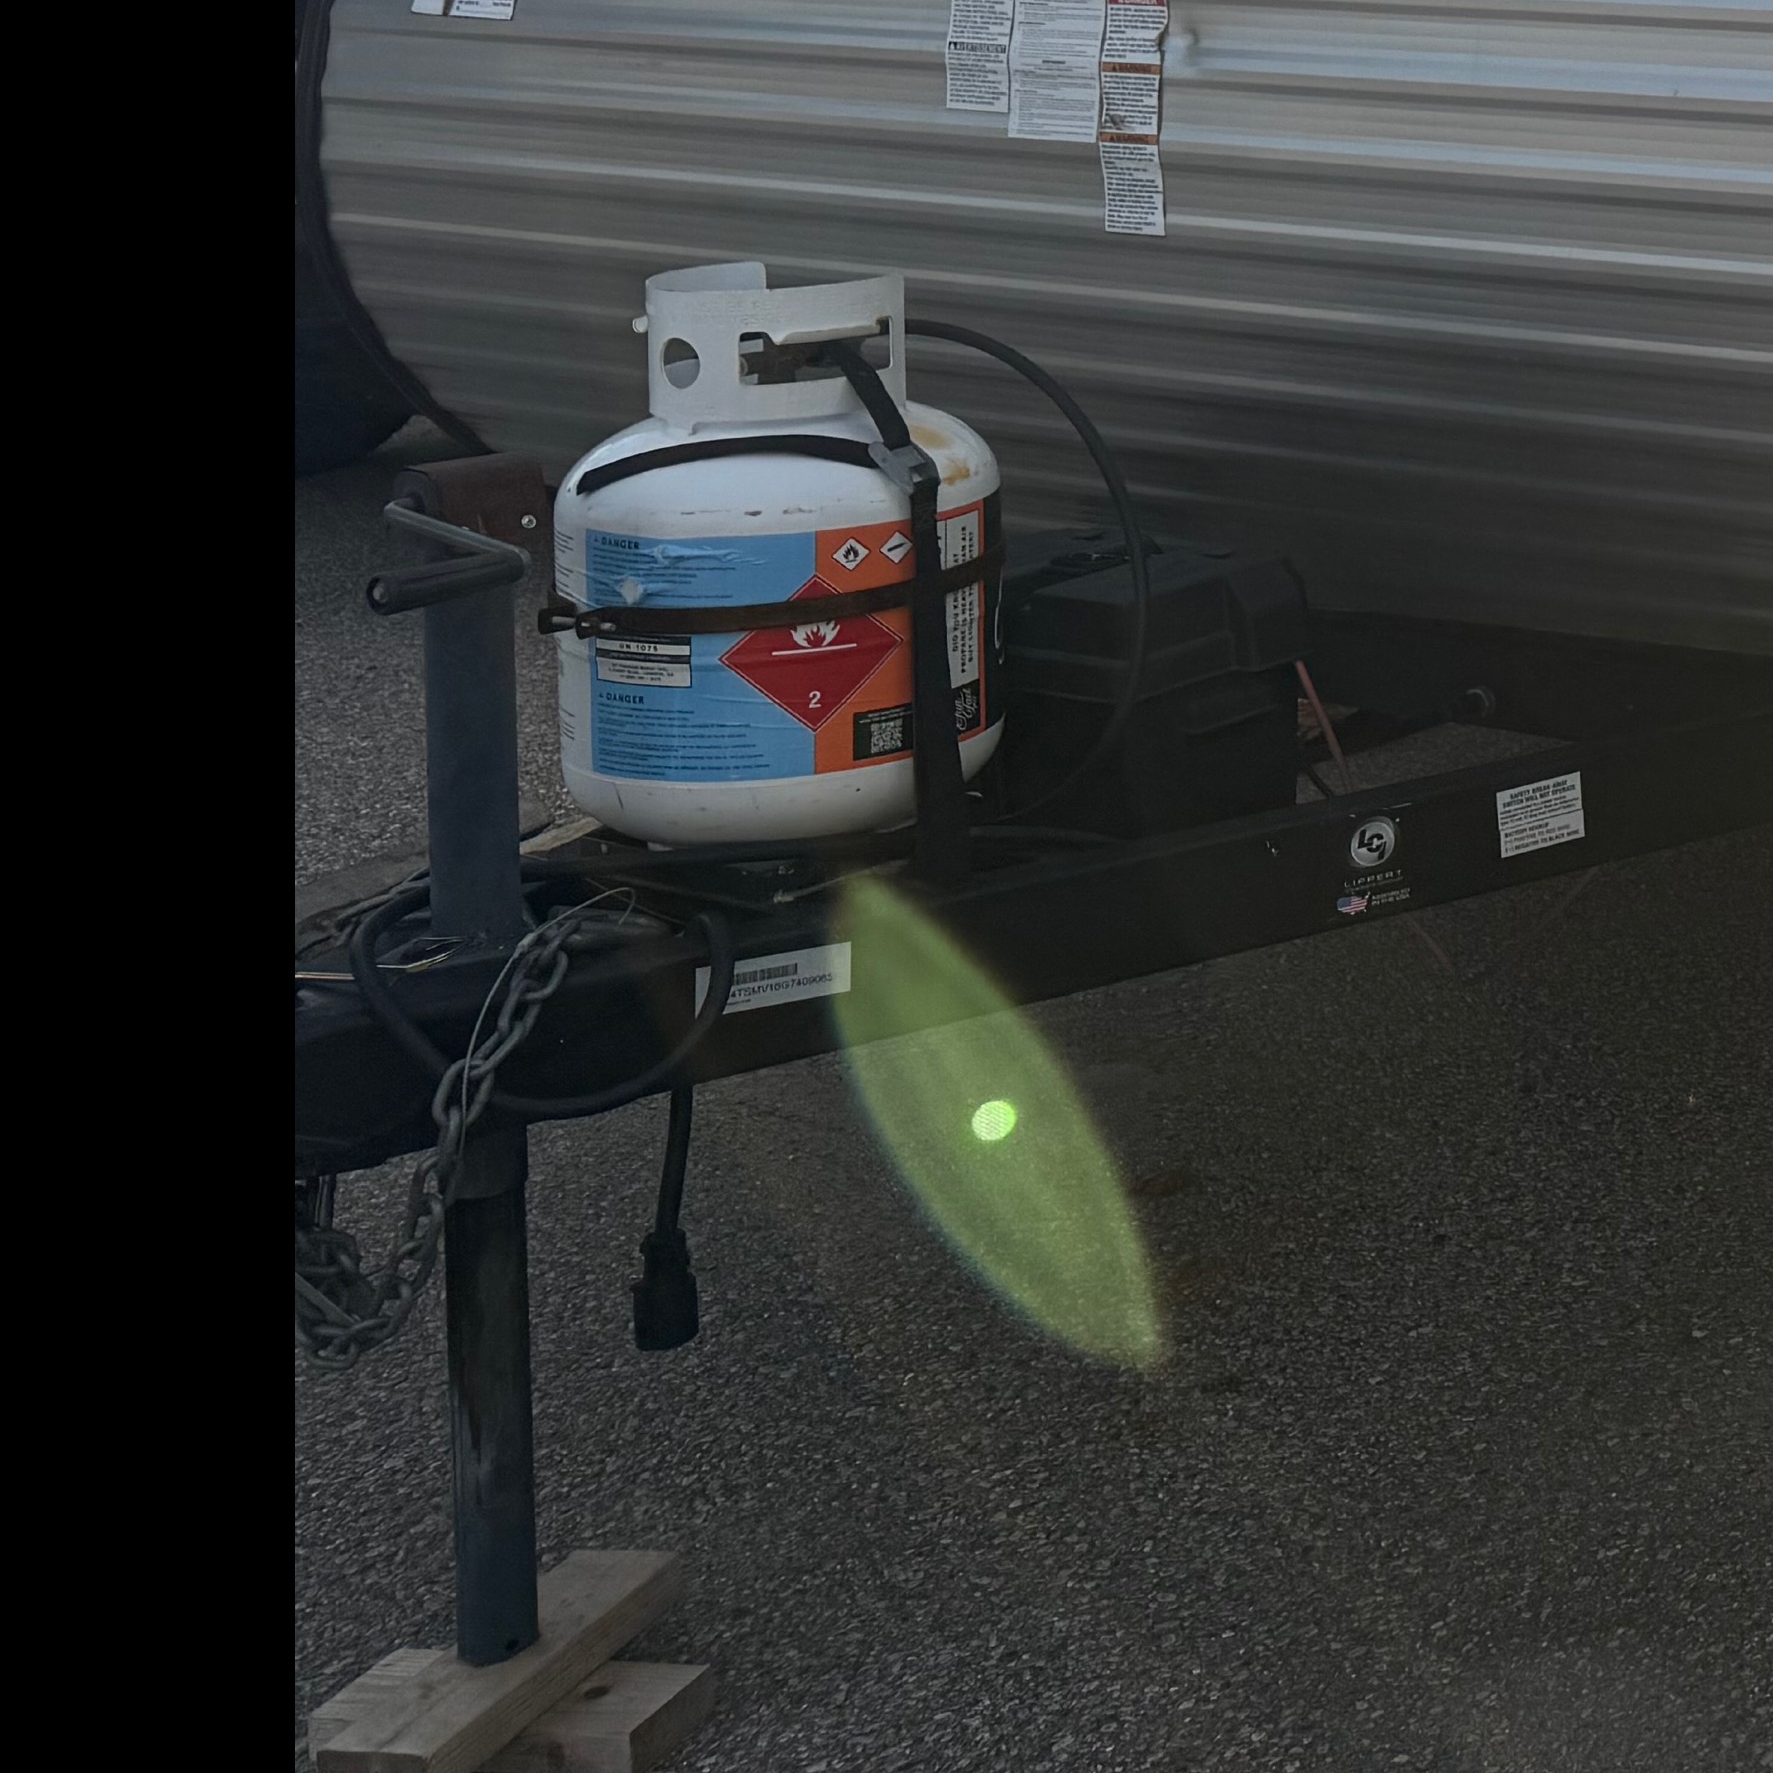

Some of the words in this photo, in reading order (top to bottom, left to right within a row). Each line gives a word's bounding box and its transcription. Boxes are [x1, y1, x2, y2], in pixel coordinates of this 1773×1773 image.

[601, 536, 640, 550] DANGER
[636, 643, 658, 652] 1075
[606, 692, 645, 705] DANGER
[808, 690, 822, 709] 2
[1344, 869, 1401, 887] LIPPERT
